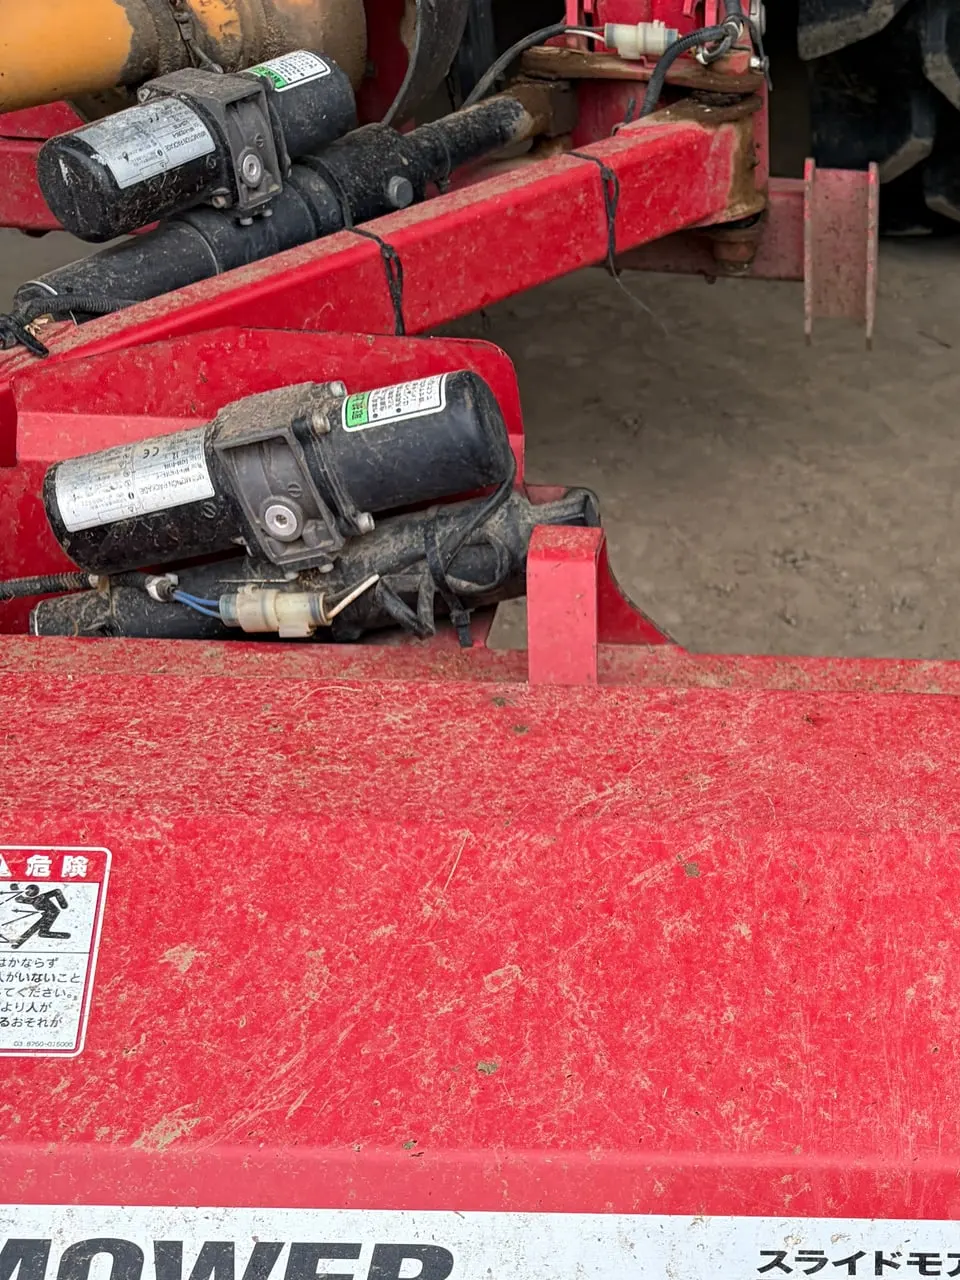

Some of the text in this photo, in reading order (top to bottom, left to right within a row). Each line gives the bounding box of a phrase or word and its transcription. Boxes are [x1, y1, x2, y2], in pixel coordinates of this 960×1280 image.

[25, 854, 89, 878] 危険
[0, 987, 72, 998] てください。
[0, 1016, 62, 1028] るおそれが
